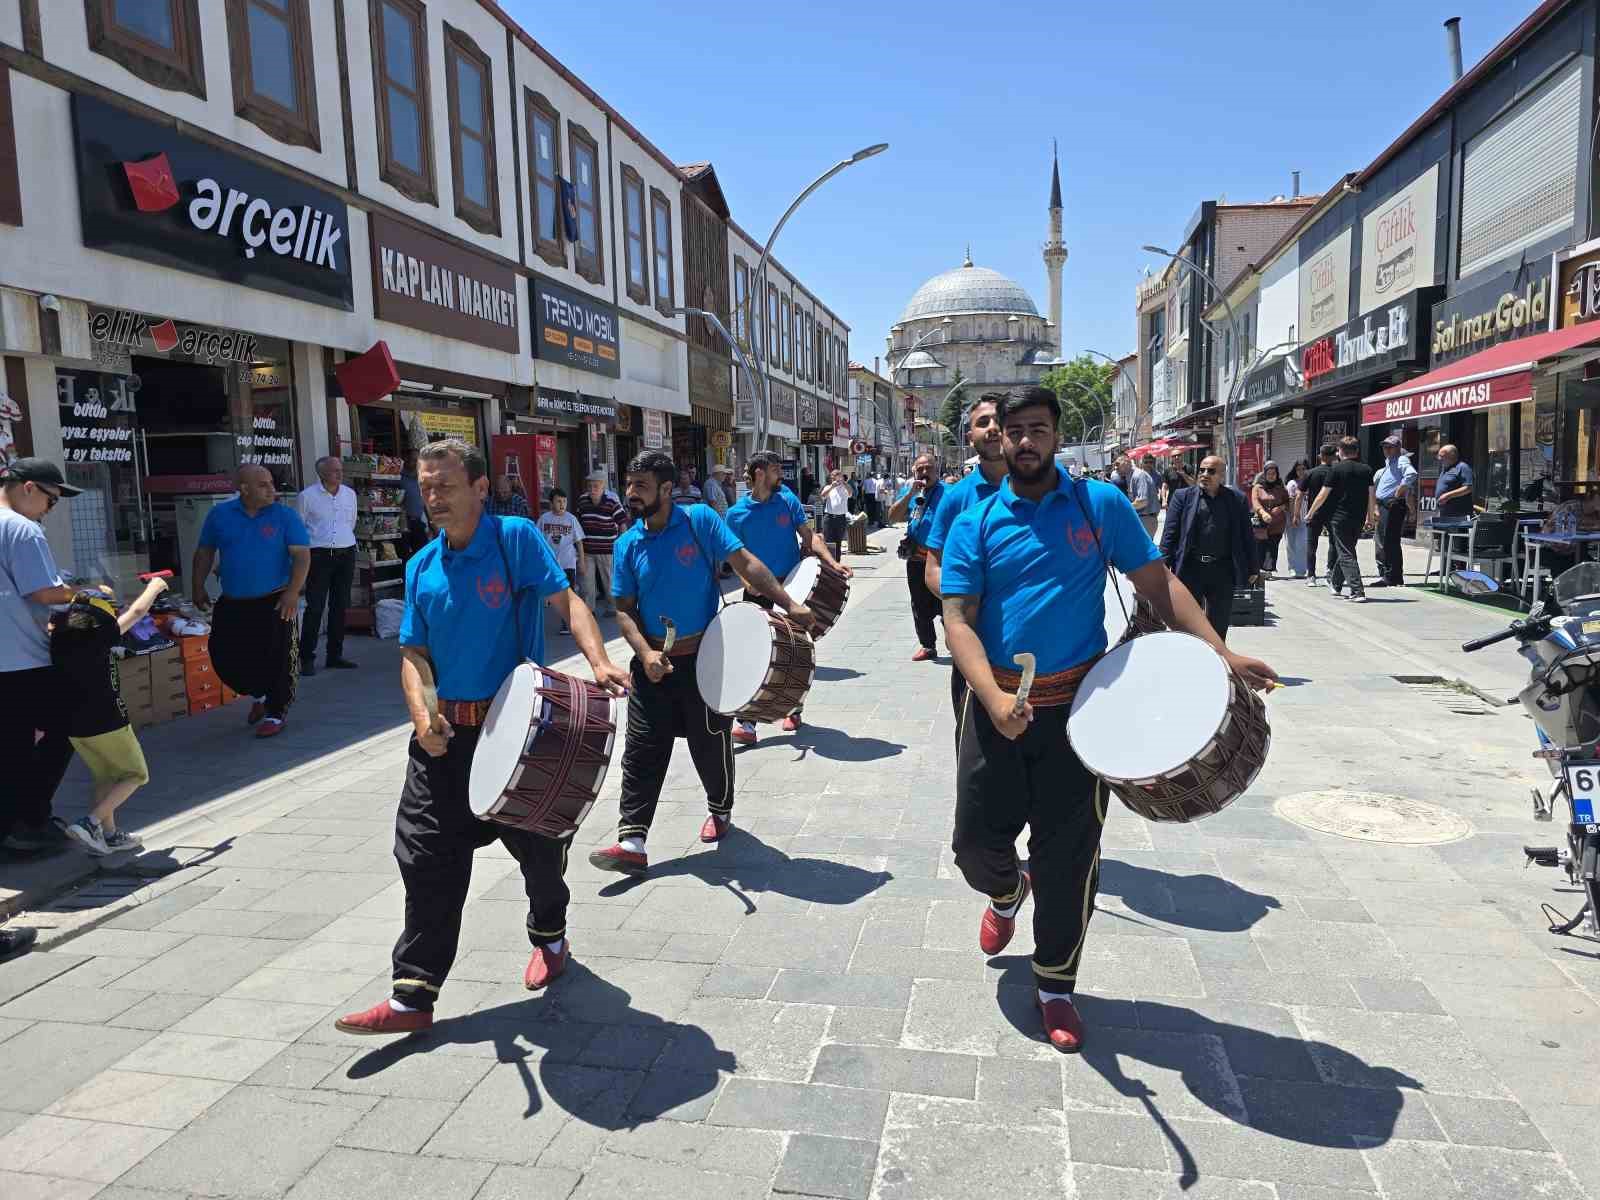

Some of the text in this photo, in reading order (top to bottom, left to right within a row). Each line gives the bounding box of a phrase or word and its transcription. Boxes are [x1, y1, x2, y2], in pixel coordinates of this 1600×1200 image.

[188, 178, 342, 270] arçelik
[381, 247, 516, 329] KAPLAN MARKET
[1496, 277, 1548, 332] Gold
[87, 310, 146, 348] elik
[541, 292, 584, 331] TREND
[181, 327, 258, 366] arçelik
[1336, 316, 1377, 368] Tavuk
[73, 401, 108, 419] bütün
[1385, 382, 1491, 418] BOLU LOKANTASI
[89, 427, 132, 442] eşyalar
[72, 448, 88, 463] ay
[90, 447, 132, 462] taksitle
[1575, 768, 1600, 792] 6
[1577, 813, 1592, 822] TR
